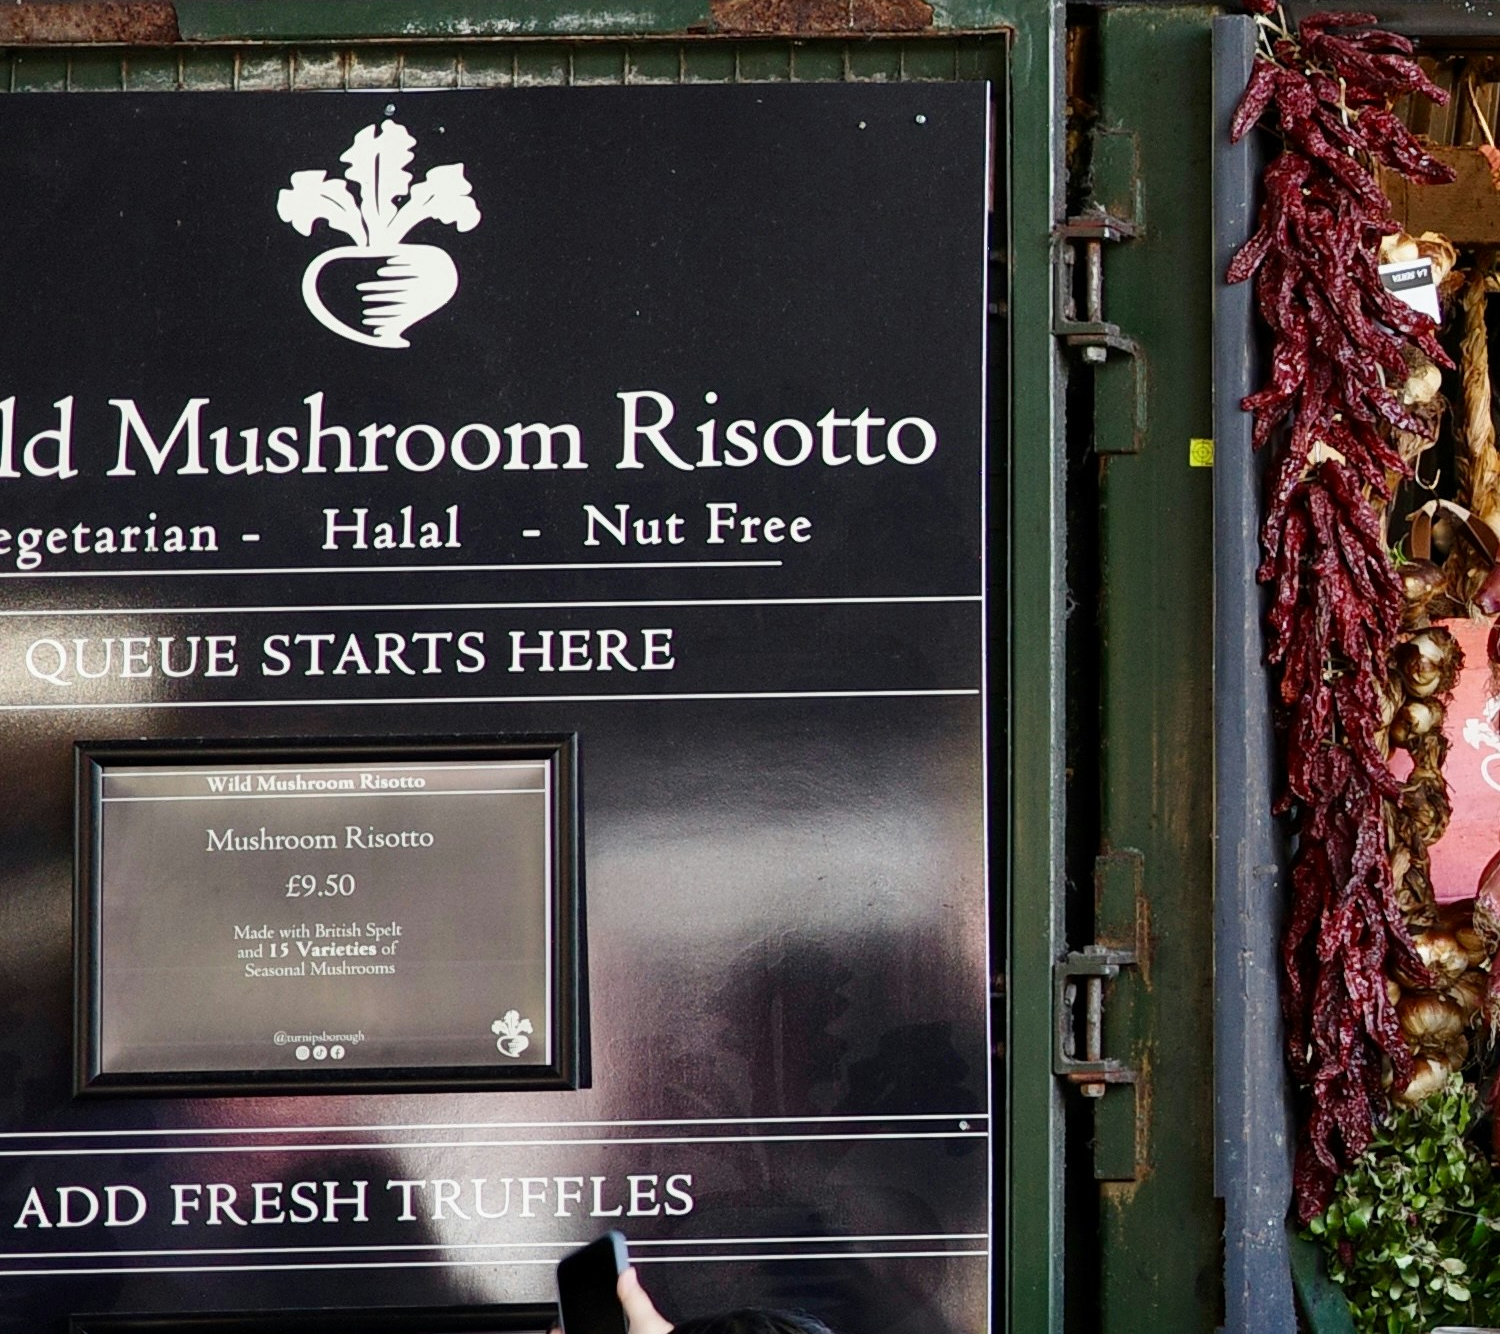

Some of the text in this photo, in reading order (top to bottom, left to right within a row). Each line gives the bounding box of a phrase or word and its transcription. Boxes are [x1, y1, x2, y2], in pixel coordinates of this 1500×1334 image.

[0, 390, 937, 480] ld Mushroom Risotto
[0, 502, 812, 570] egetarian Halal Nut Free
[24, 628, 675, 686] QUEUE STARTS HERE
[206, 773, 426, 793] Wild Mushroom Risotto
[206, 826, 434, 852] Mushroom Risotto
[285, 873, 355, 897] £9.50
[234, 921, 402, 945] Made with British Spelt
[237, 939, 399, 959] and 15 Varieties of
[244, 960, 397, 980] Seasonal Mushrooms
[273, 1029, 365, 1046] @turnipsborough
[13, 1173, 695, 1229] ADD FRESH TRUFFLES
